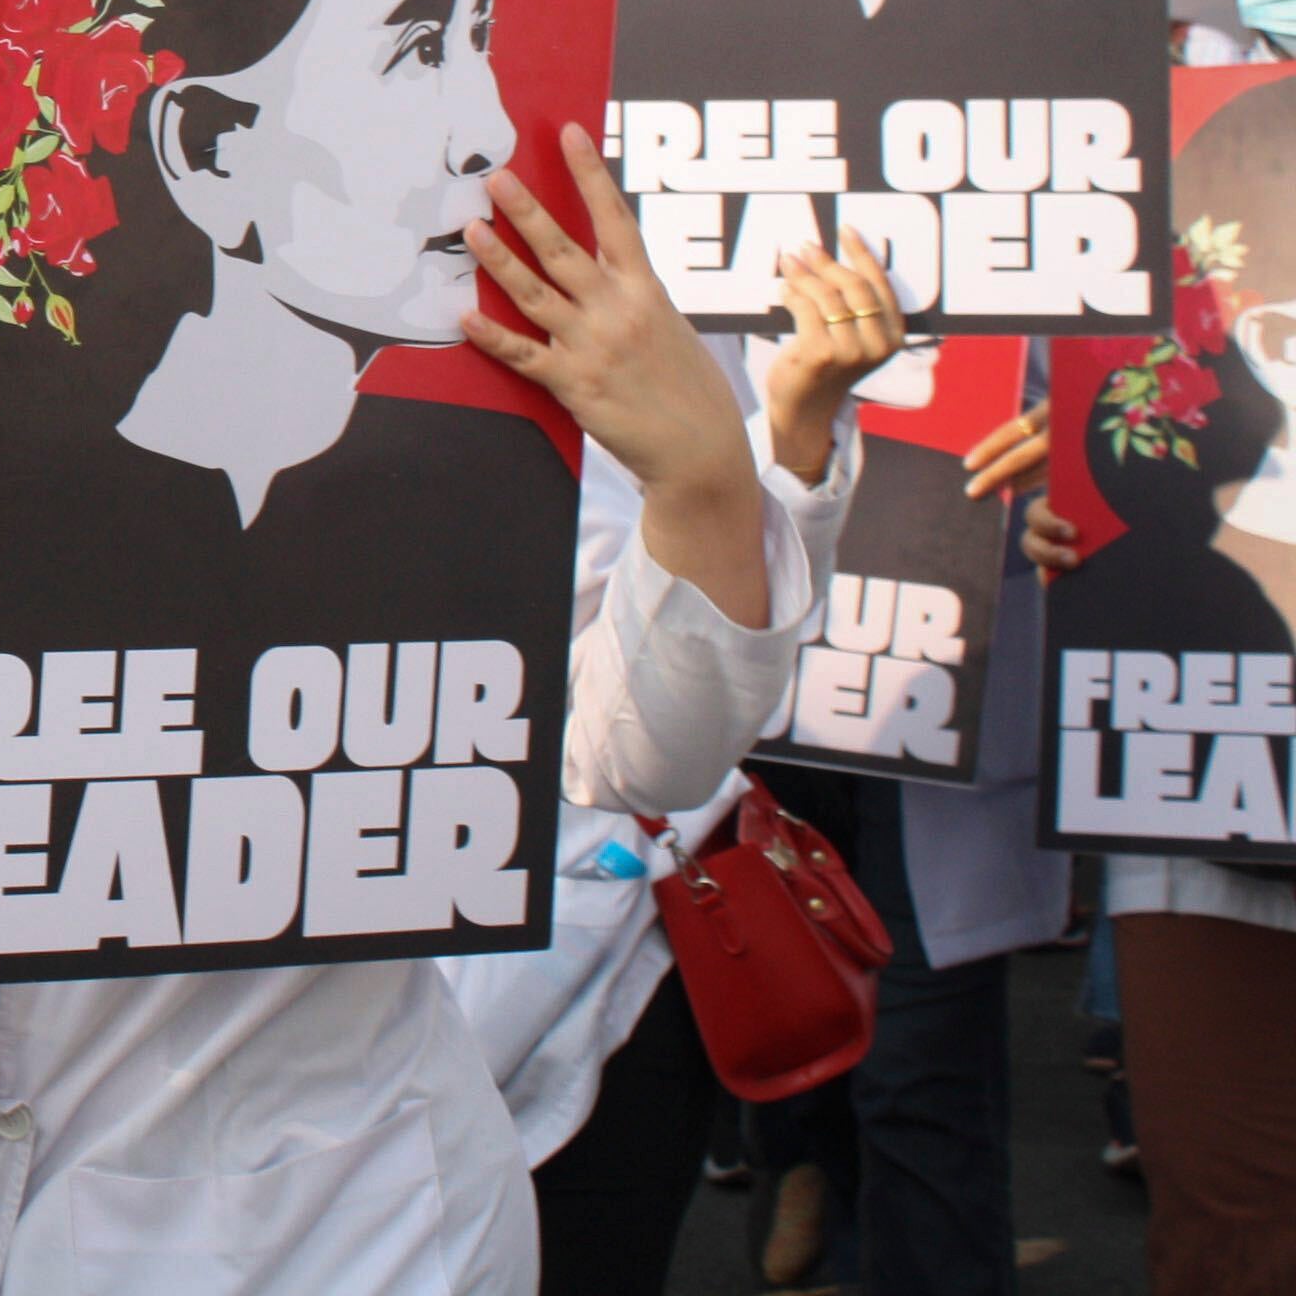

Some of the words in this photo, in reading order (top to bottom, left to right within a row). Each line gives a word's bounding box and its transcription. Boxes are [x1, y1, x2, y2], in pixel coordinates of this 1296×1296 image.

[603, 99, 848, 192] REE
[881, 98, 1143, 192] OUR
[248, 639, 530, 772] OUR
[1060, 649, 1296, 736] FREE
[1056, 730, 1296, 843] LEA
